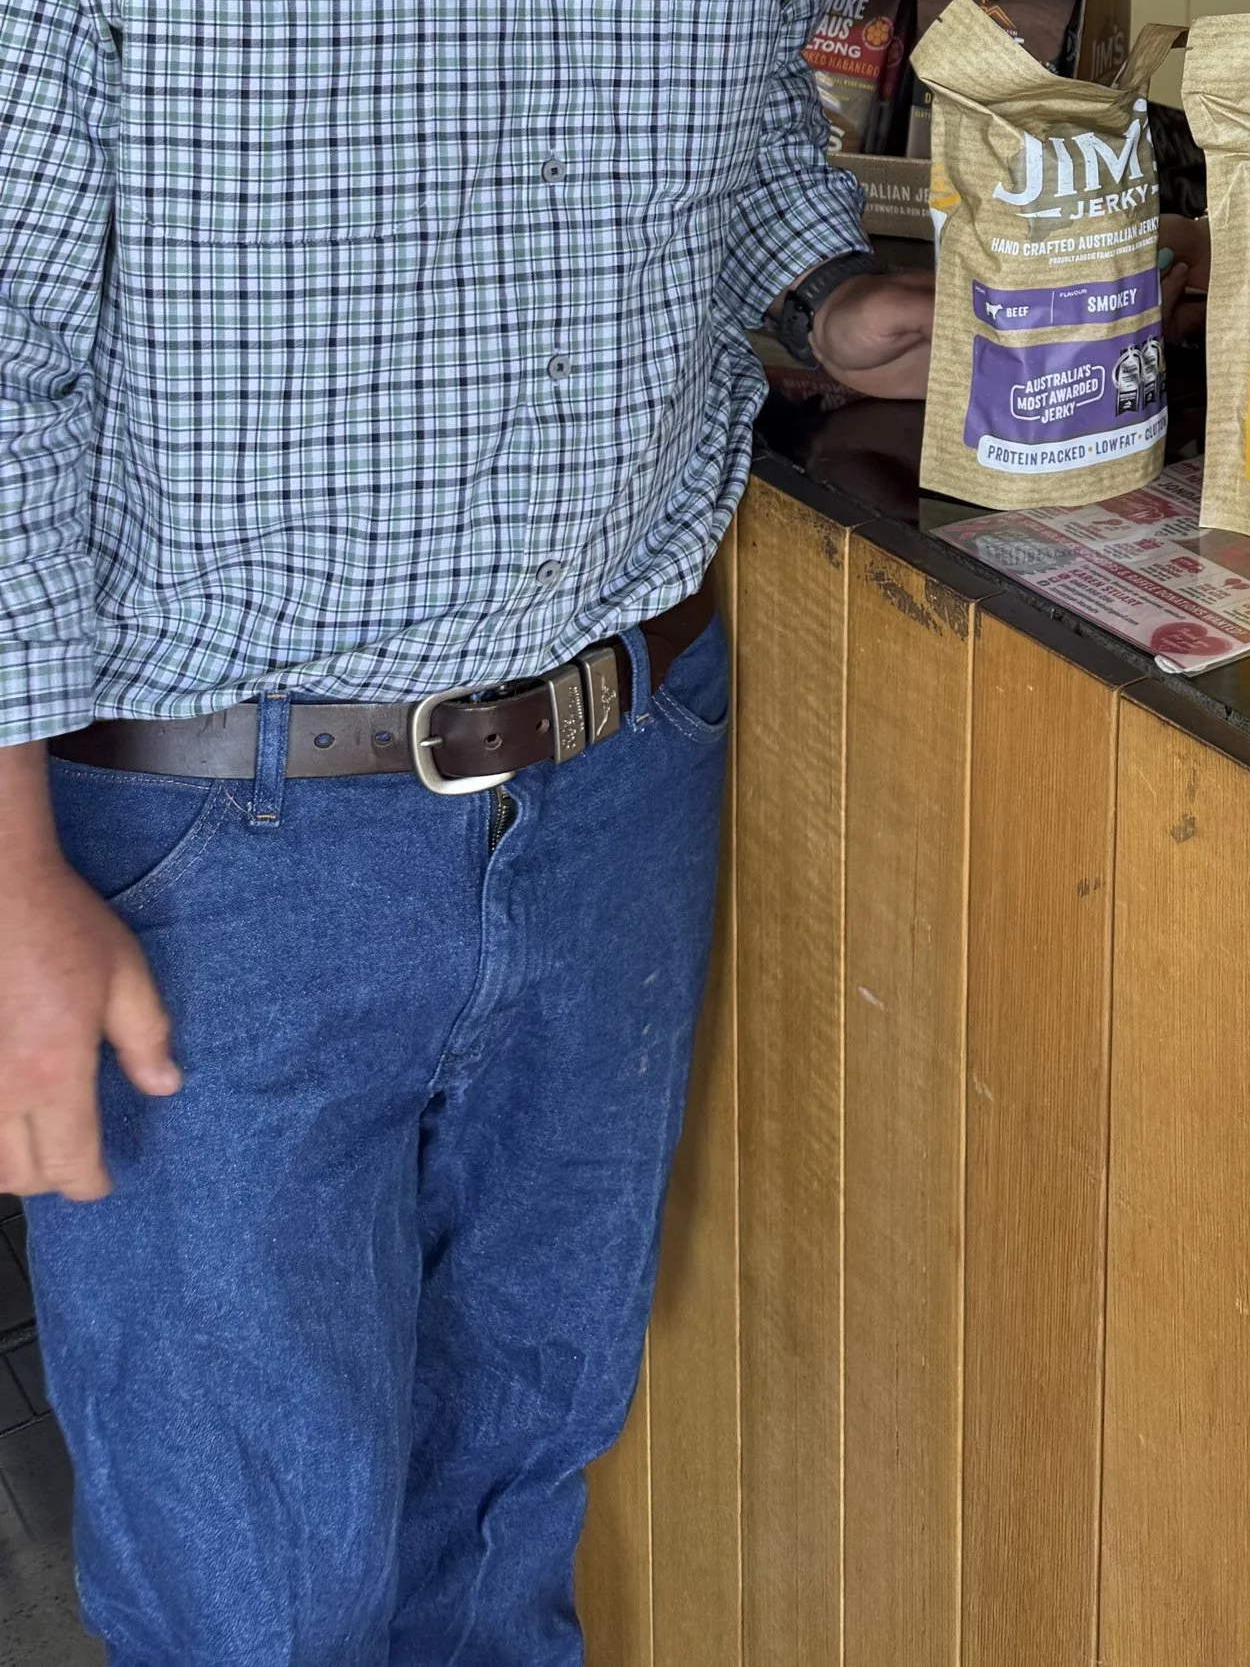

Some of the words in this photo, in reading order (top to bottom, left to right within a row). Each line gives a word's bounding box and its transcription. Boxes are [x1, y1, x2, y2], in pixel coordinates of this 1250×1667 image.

[815, 15, 853, 40] AUS
[1070, 184, 1149, 220] JERKY
[991, 237, 1020, 256] HAND
[1023, 238, 1075, 257] CRAFTED
[1078, 227, 1138, 251] AUSTRALIAN
[1006, 306, 1029, 318] BEEF
[1088, 288, 1138, 312] SMOKEY
[1025, 364, 1091, 394] AUSTRALIA'S
[1017, 394, 1050, 411] MOST
[1049, 378, 1099, 405] AWARDED
[1041, 402, 1075, 424] JERKY
[988, 445, 1037, 466] PROTEIN
[1040, 445, 1085, 465] PACKED
[1095, 438, 1118, 455] LOW
[1119, 432, 1137, 450] FAT
[1067, 567, 1108, 588] KAREN
[1100, 585, 1143, 607] STUART
[1153, 588, 1208, 616] DONATIONS
